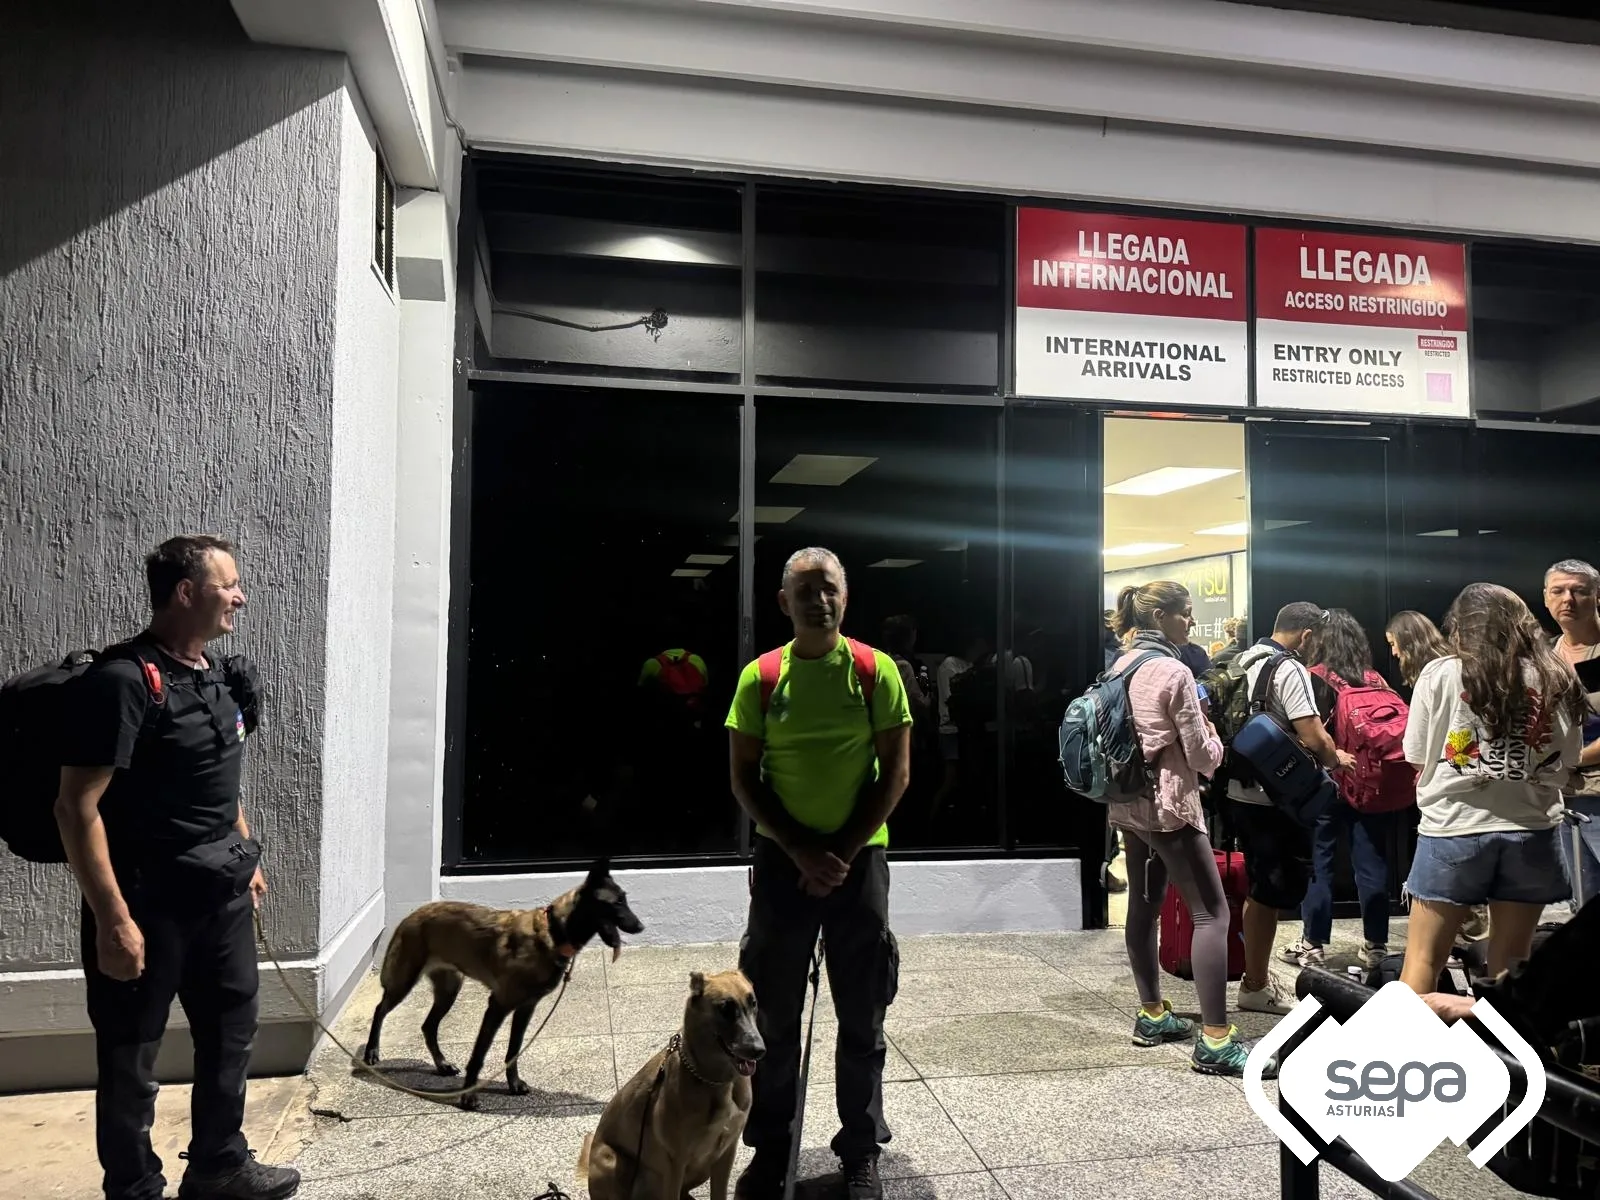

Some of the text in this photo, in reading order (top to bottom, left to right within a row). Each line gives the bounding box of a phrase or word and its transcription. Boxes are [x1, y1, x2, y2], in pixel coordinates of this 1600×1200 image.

[1078, 230, 1190, 265] LLEGADA
[1300, 246, 1433, 287] LLEGADA
[1033, 259, 1233, 299] INTERNACIONAL
[1285, 291, 1447, 318] ACCESO RESTRINGIDO
[1046, 336, 1226, 362] INTERNATIONAL
[1420, 338, 1455, 349] RESTRINGIDO
[1424, 350, 1451, 358] RESTRICTED
[1274, 344, 1402, 367] ENTRY ONLY
[1081, 359, 1192, 382] ARRIVALS
[1272, 368, 1405, 388] RESTRICTED ACCESS
[1275, 756, 1297, 777] LiveU
